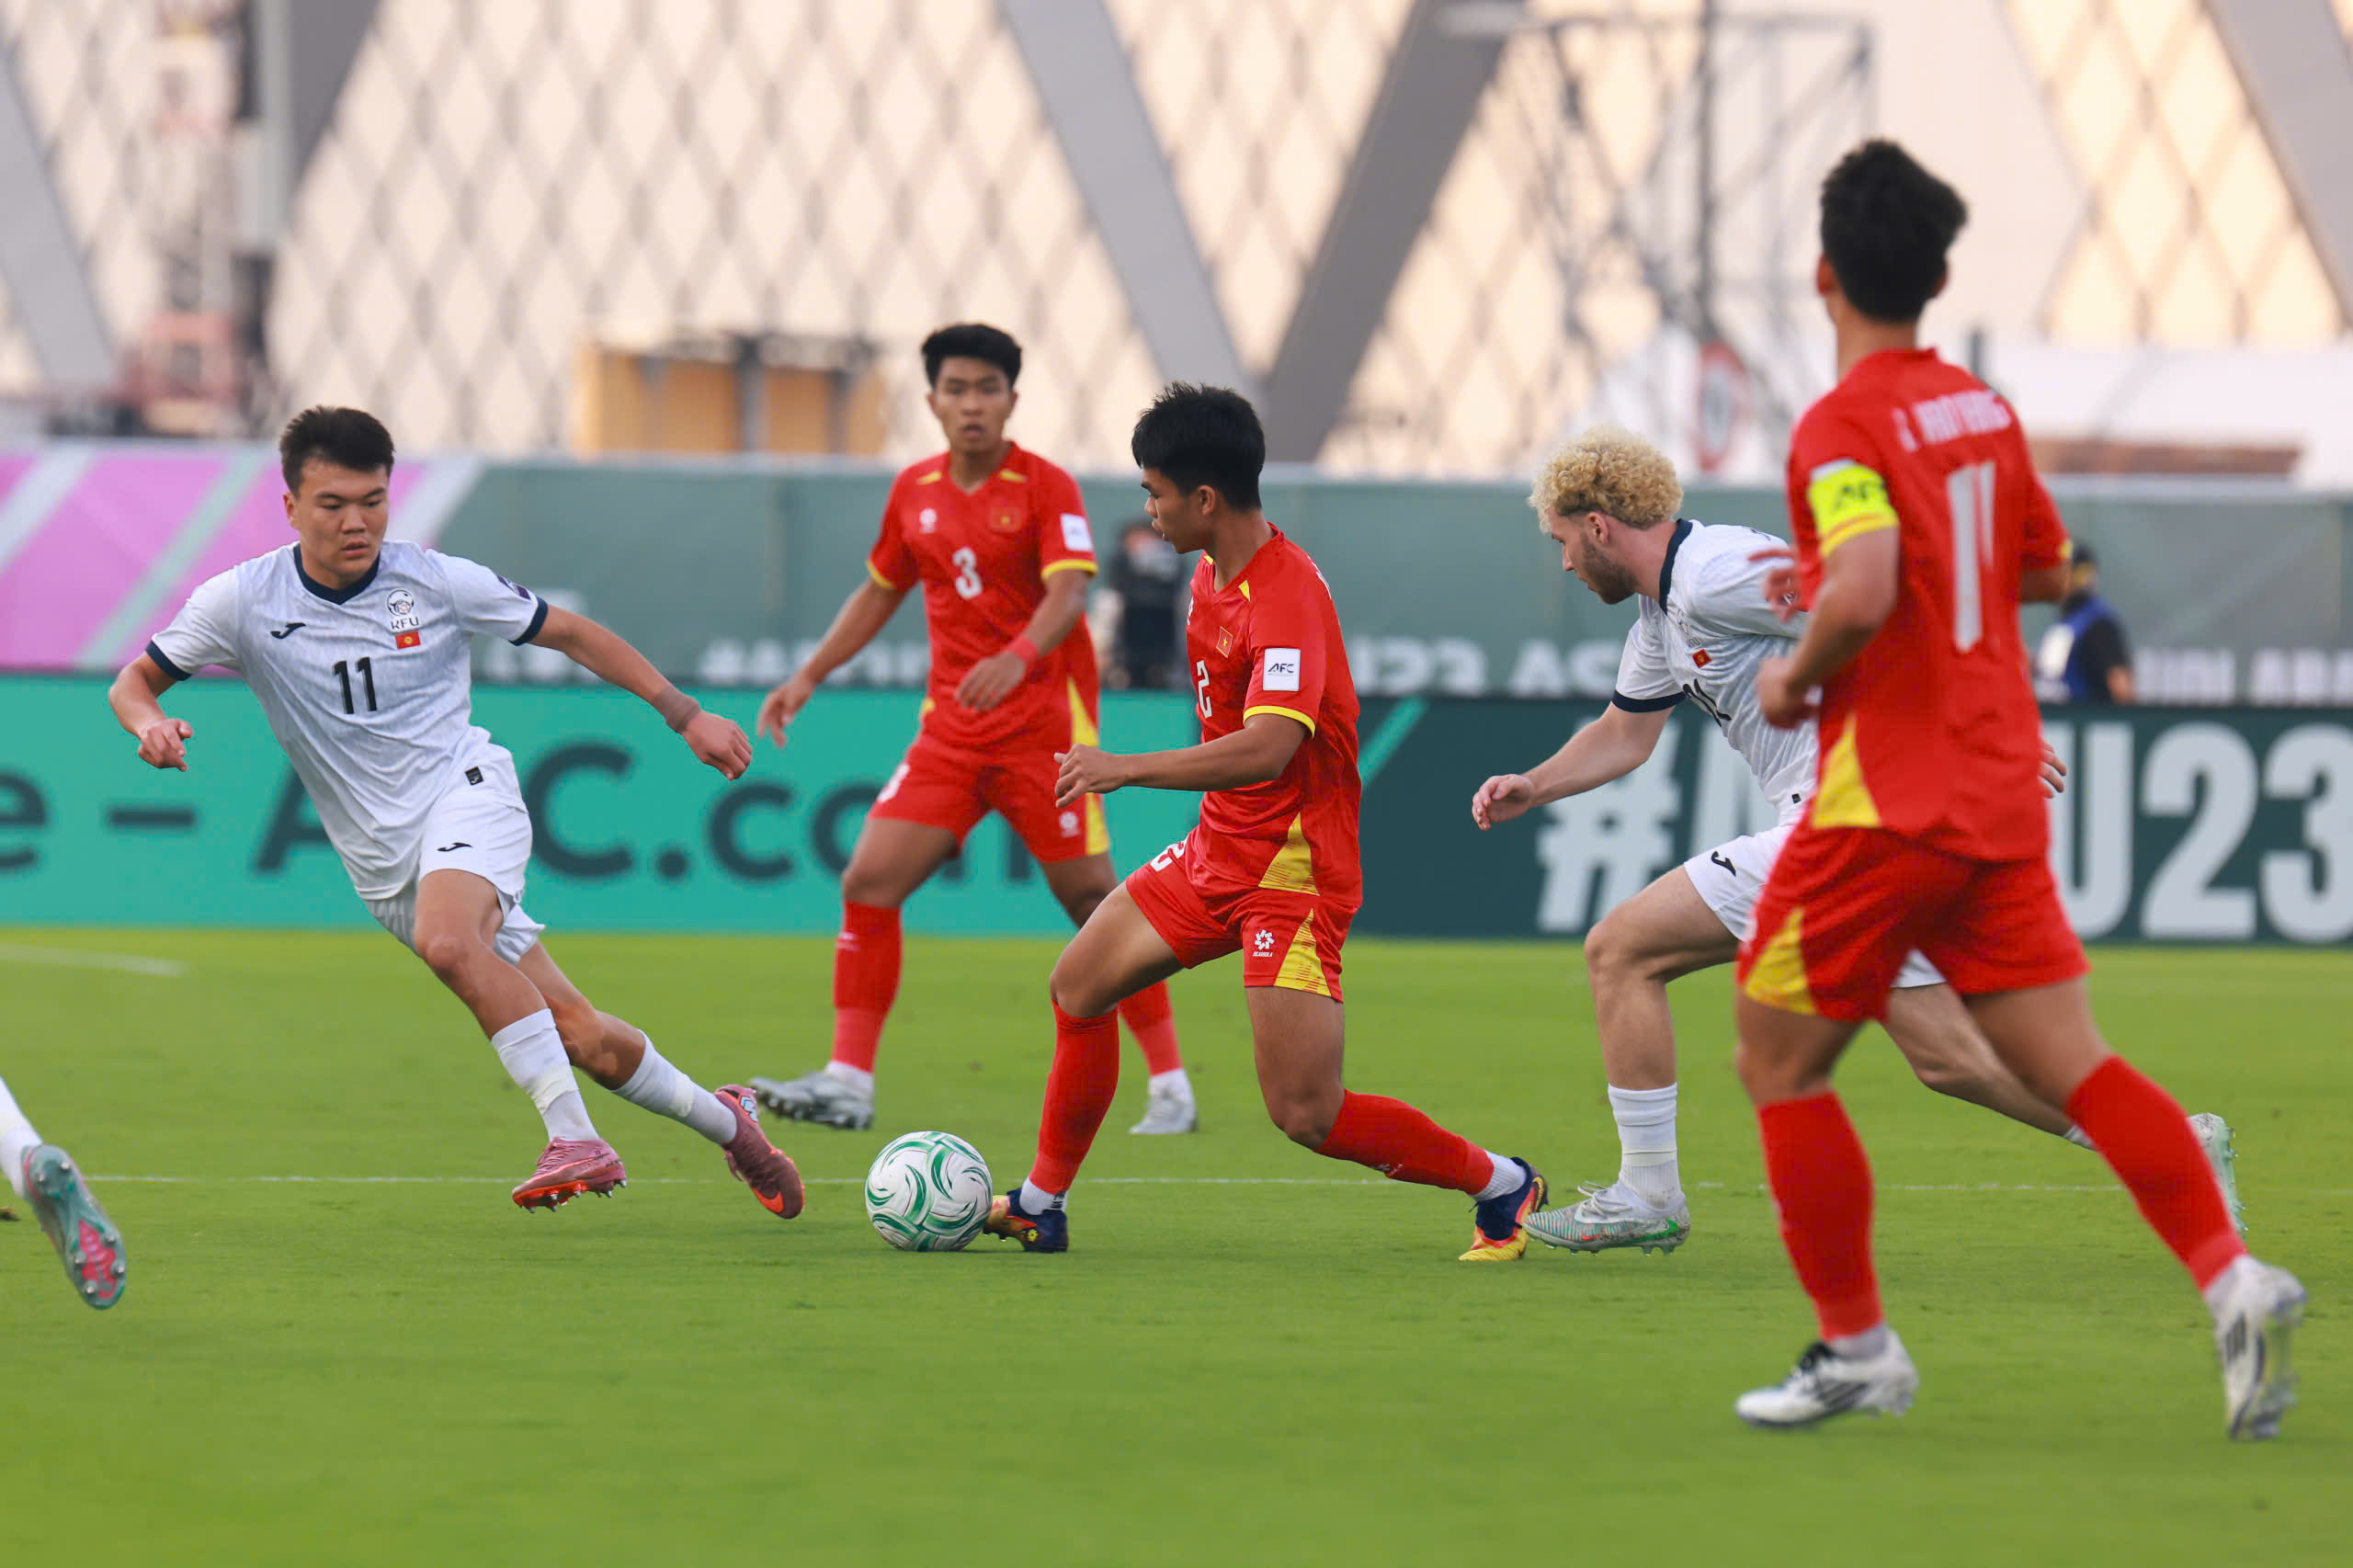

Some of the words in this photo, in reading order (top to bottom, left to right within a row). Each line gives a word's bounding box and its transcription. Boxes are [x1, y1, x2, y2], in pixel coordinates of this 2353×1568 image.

[952, 547, 983, 600] 3
[390, 616, 419, 630] KFU
[333, 656, 378, 715] 11
[1196, 660, 1212, 719] 2
[1268, 663, 1294, 673] AFC
